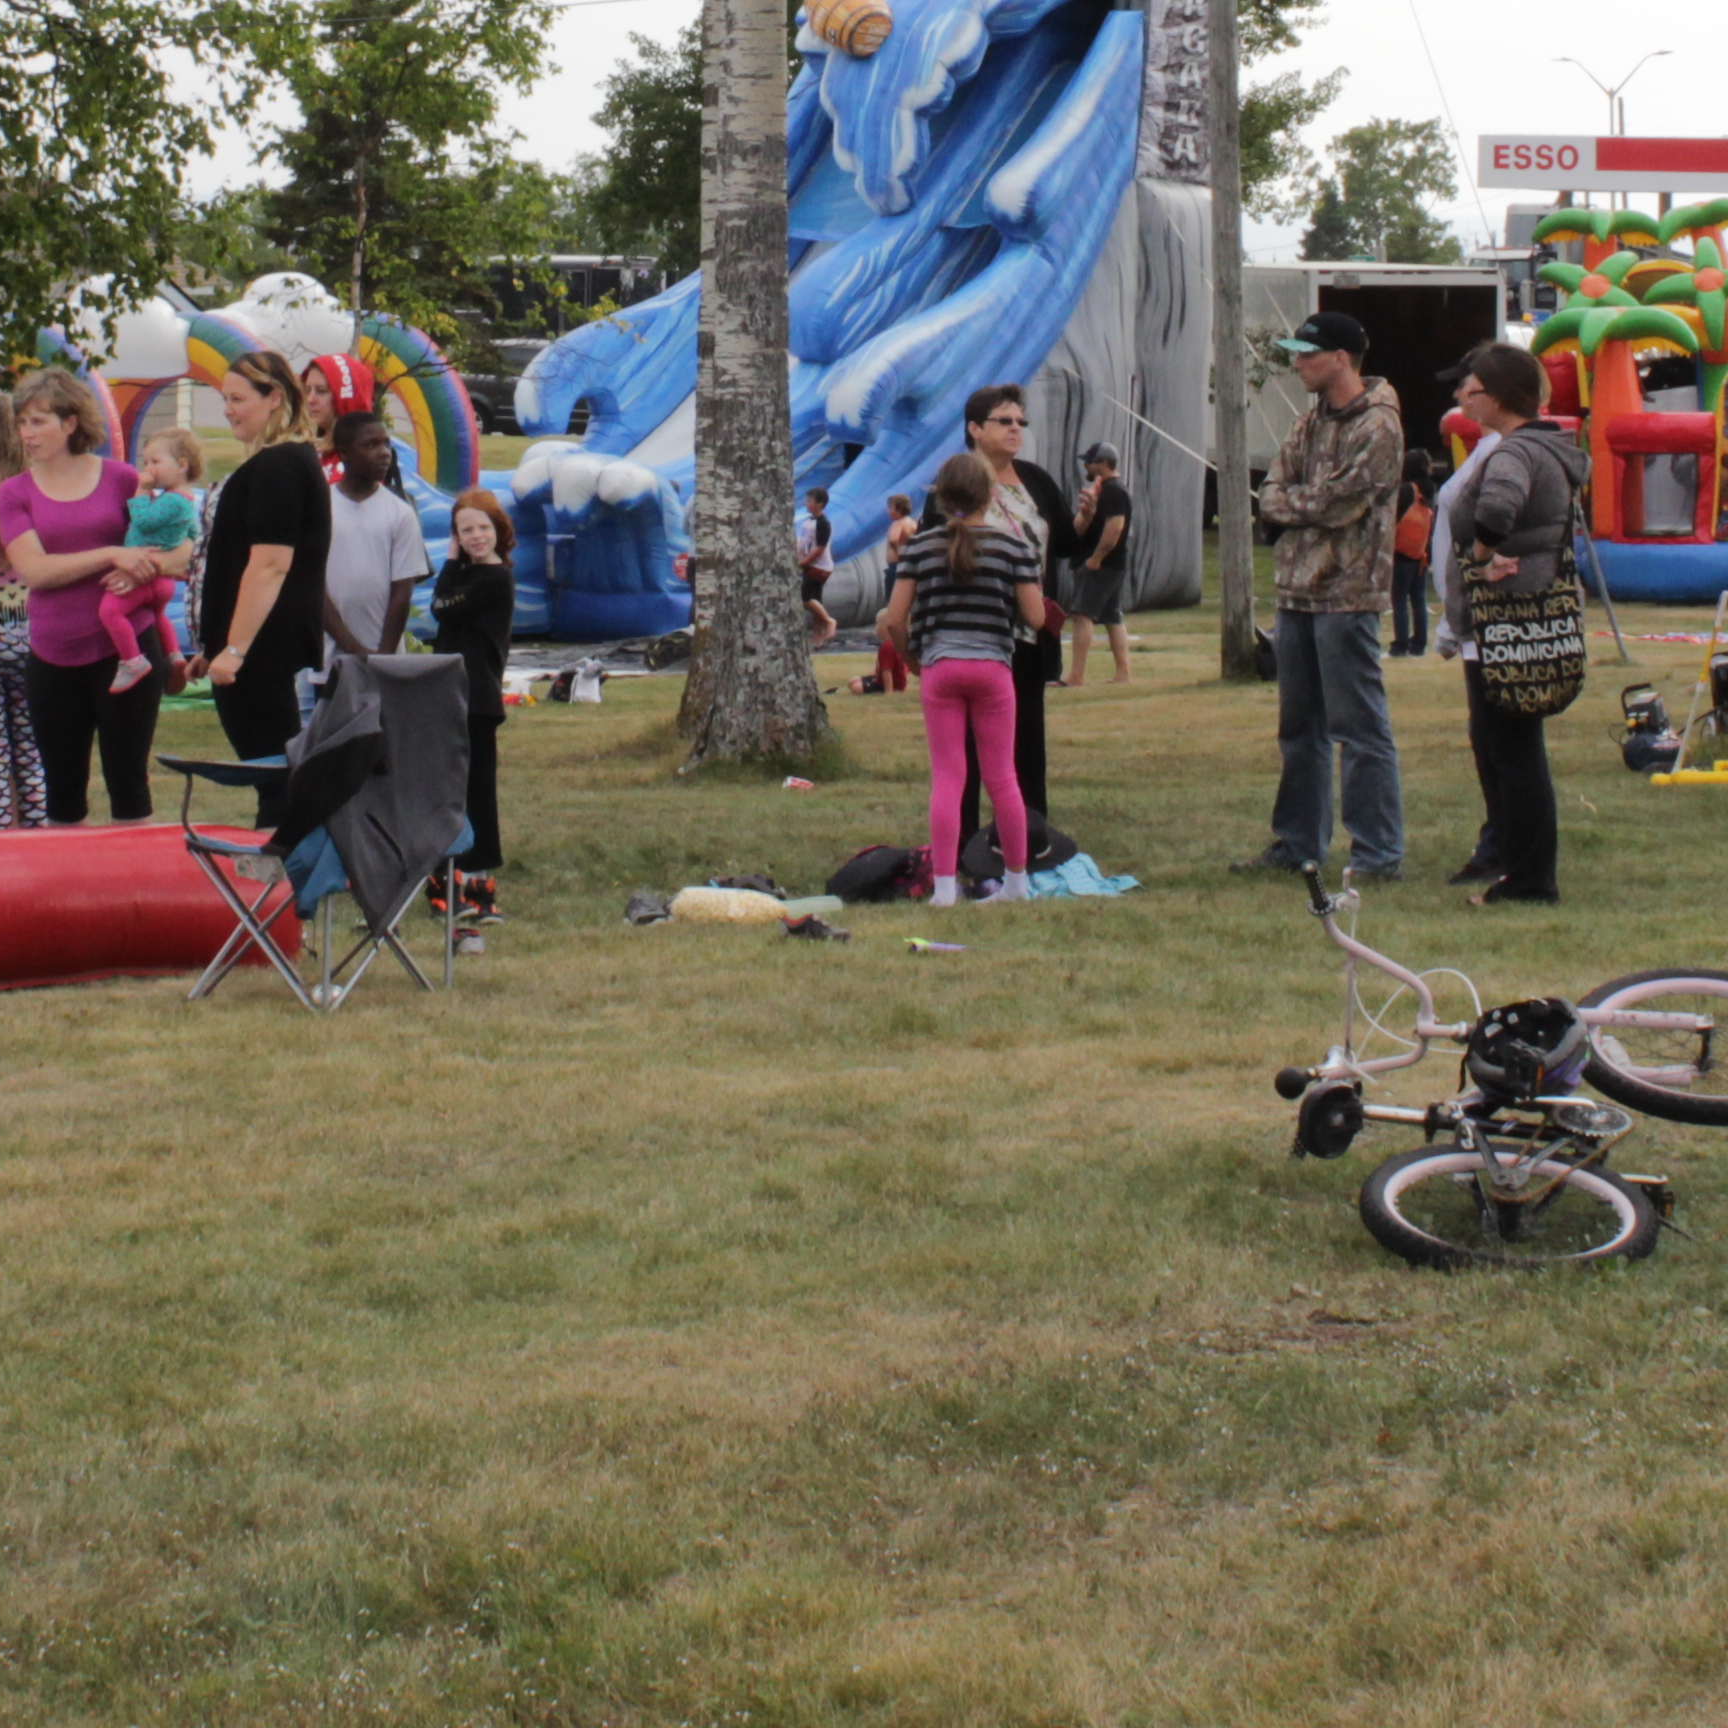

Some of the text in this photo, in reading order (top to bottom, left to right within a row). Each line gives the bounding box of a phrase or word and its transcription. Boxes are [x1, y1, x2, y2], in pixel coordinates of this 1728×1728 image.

[1494, 144, 1579, 170] ESSO
[1484, 616, 1576, 643] REPUBLICA
[1482, 636, 1584, 664] DOMINICANA
